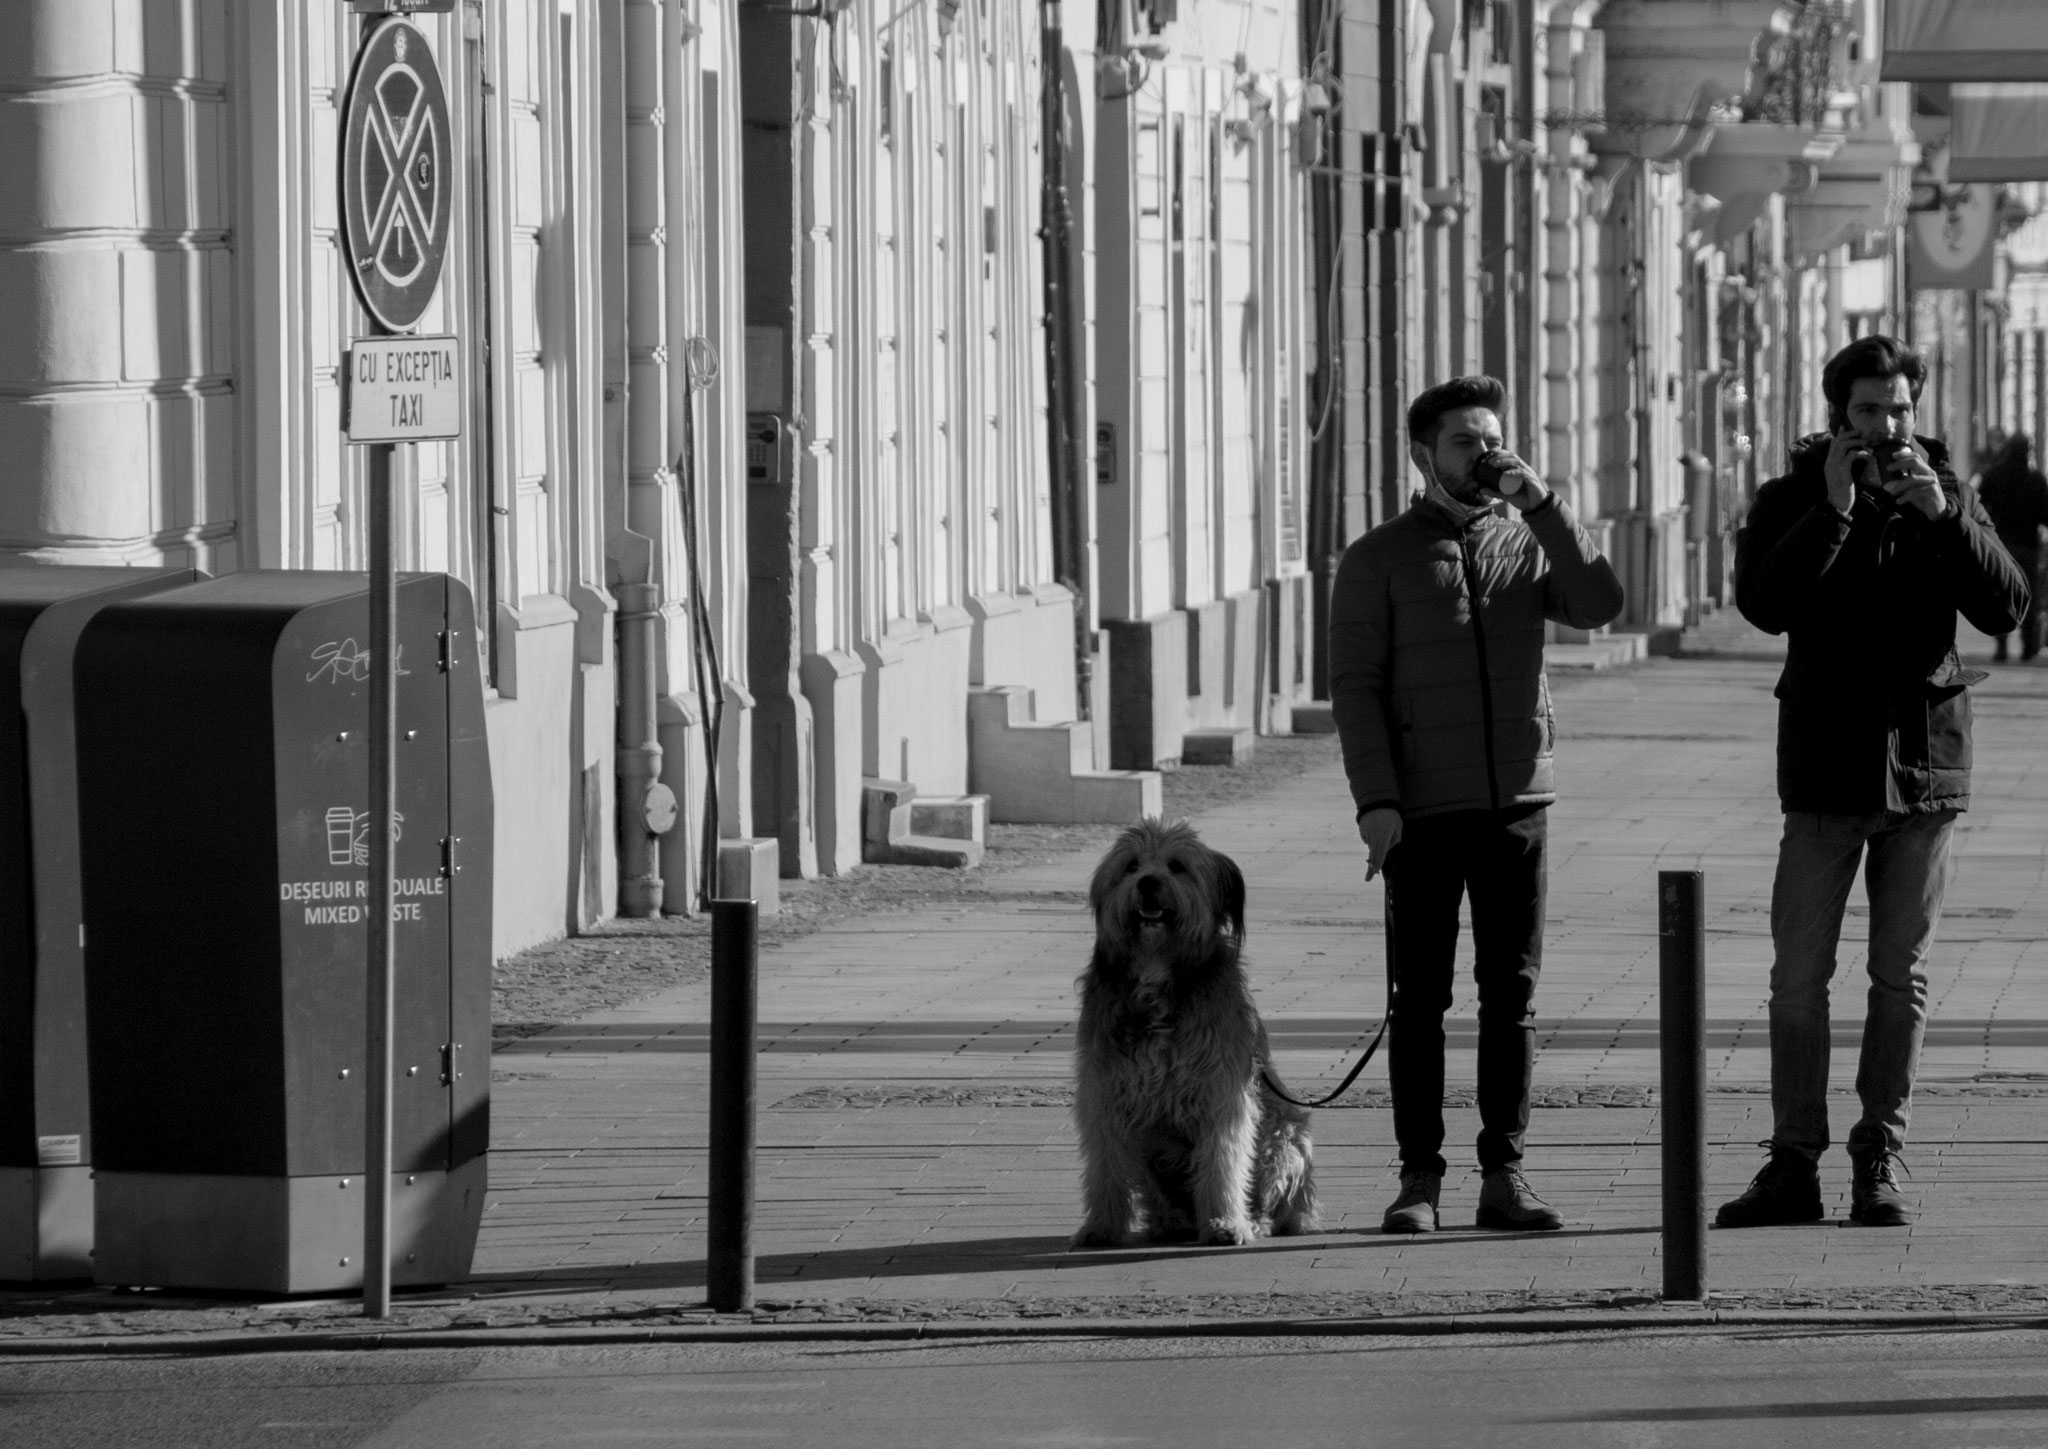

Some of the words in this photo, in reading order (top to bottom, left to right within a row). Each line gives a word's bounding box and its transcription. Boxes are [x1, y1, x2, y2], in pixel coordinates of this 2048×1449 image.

[360, 353, 377, 384] CU
[387, 350, 453, 390] EXCEPȚIA
[390, 393, 423, 428] TAXI
[355, 877, 444, 898] RDUALE
[304, 905, 361, 925] MIXED
[364, 903, 421, 923] STE
